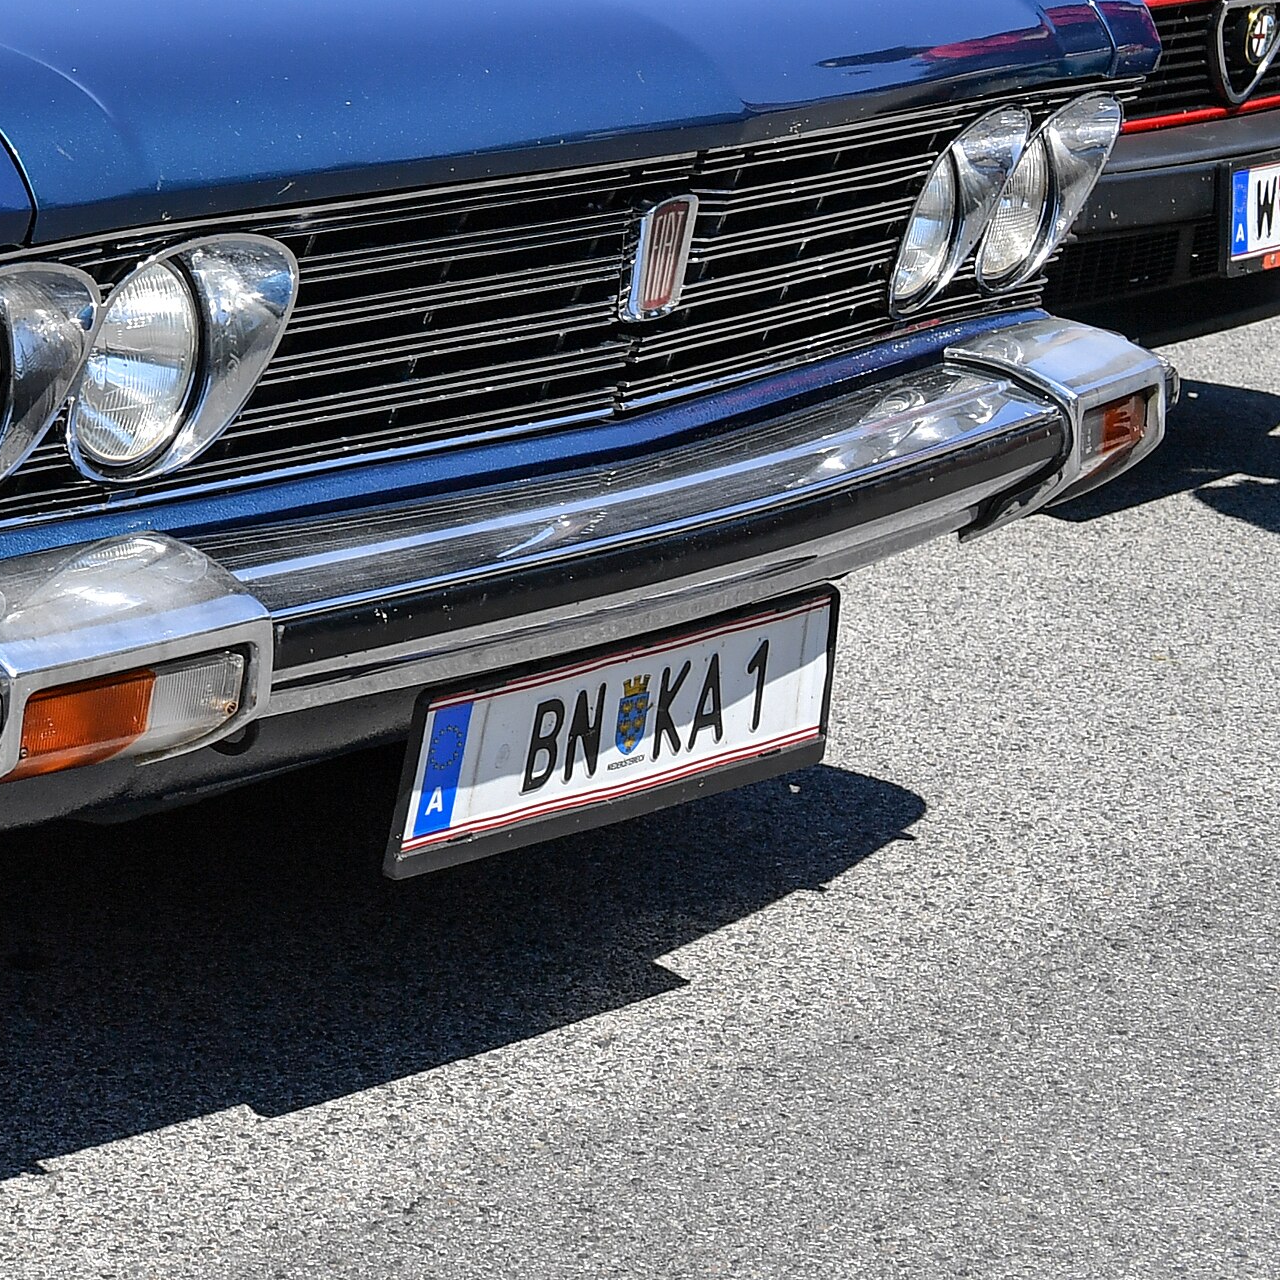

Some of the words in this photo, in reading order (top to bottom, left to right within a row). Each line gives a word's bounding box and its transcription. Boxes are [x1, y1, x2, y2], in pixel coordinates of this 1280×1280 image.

[1256, 175, 1278, 240] W
[1235, 223, 1245, 242] A
[520, 682, 607, 795] BN
[652, 653, 724, 761] KA
[747, 638, 769, 732] 1
[424, 786, 443, 816] A
